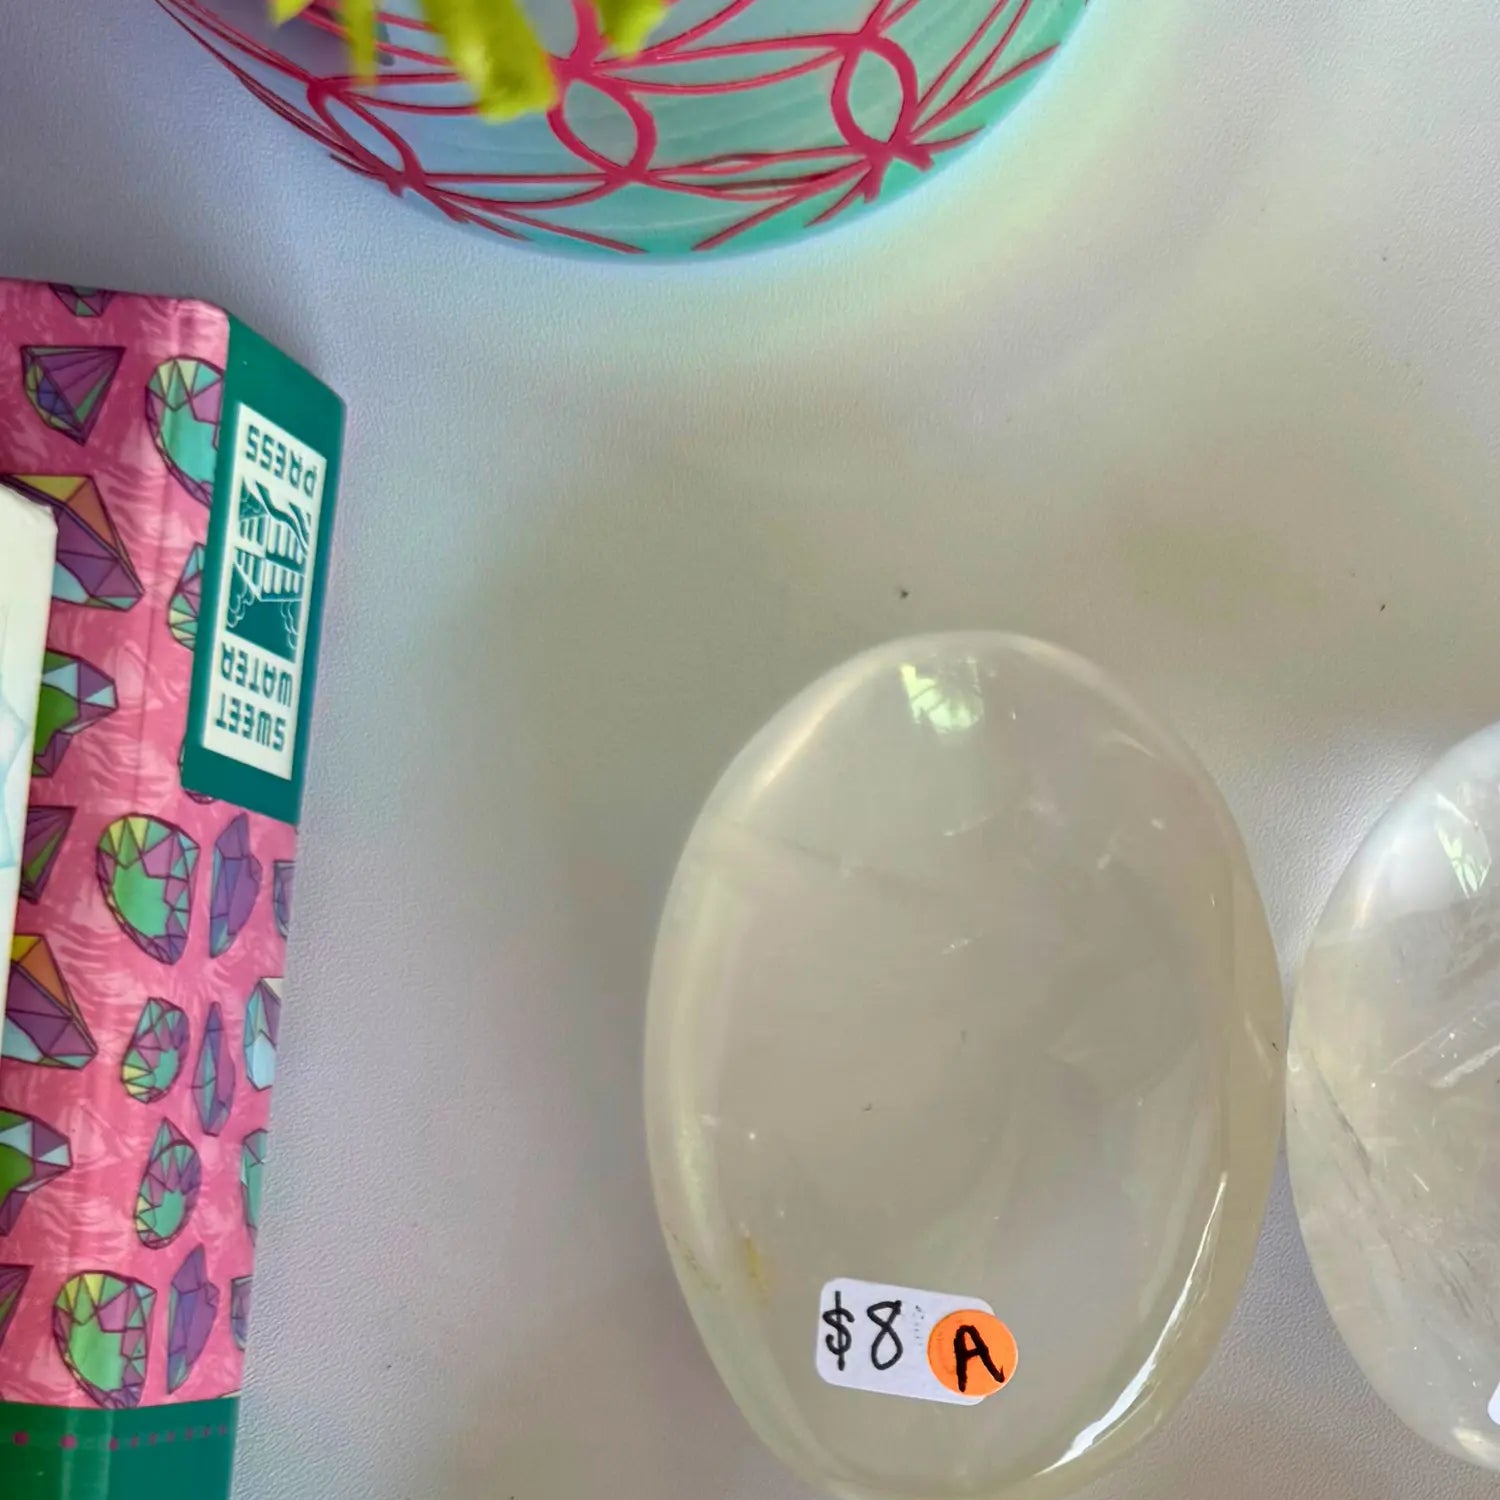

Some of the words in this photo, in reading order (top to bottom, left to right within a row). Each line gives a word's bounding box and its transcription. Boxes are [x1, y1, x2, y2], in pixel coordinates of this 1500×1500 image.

[245, 424, 318, 498] PRESS
[219, 641, 293, 708] WATER
[215, 693, 286, 753] SWEET
[822, 1290, 904, 1372] $8
[953, 1324, 1006, 1393] A
